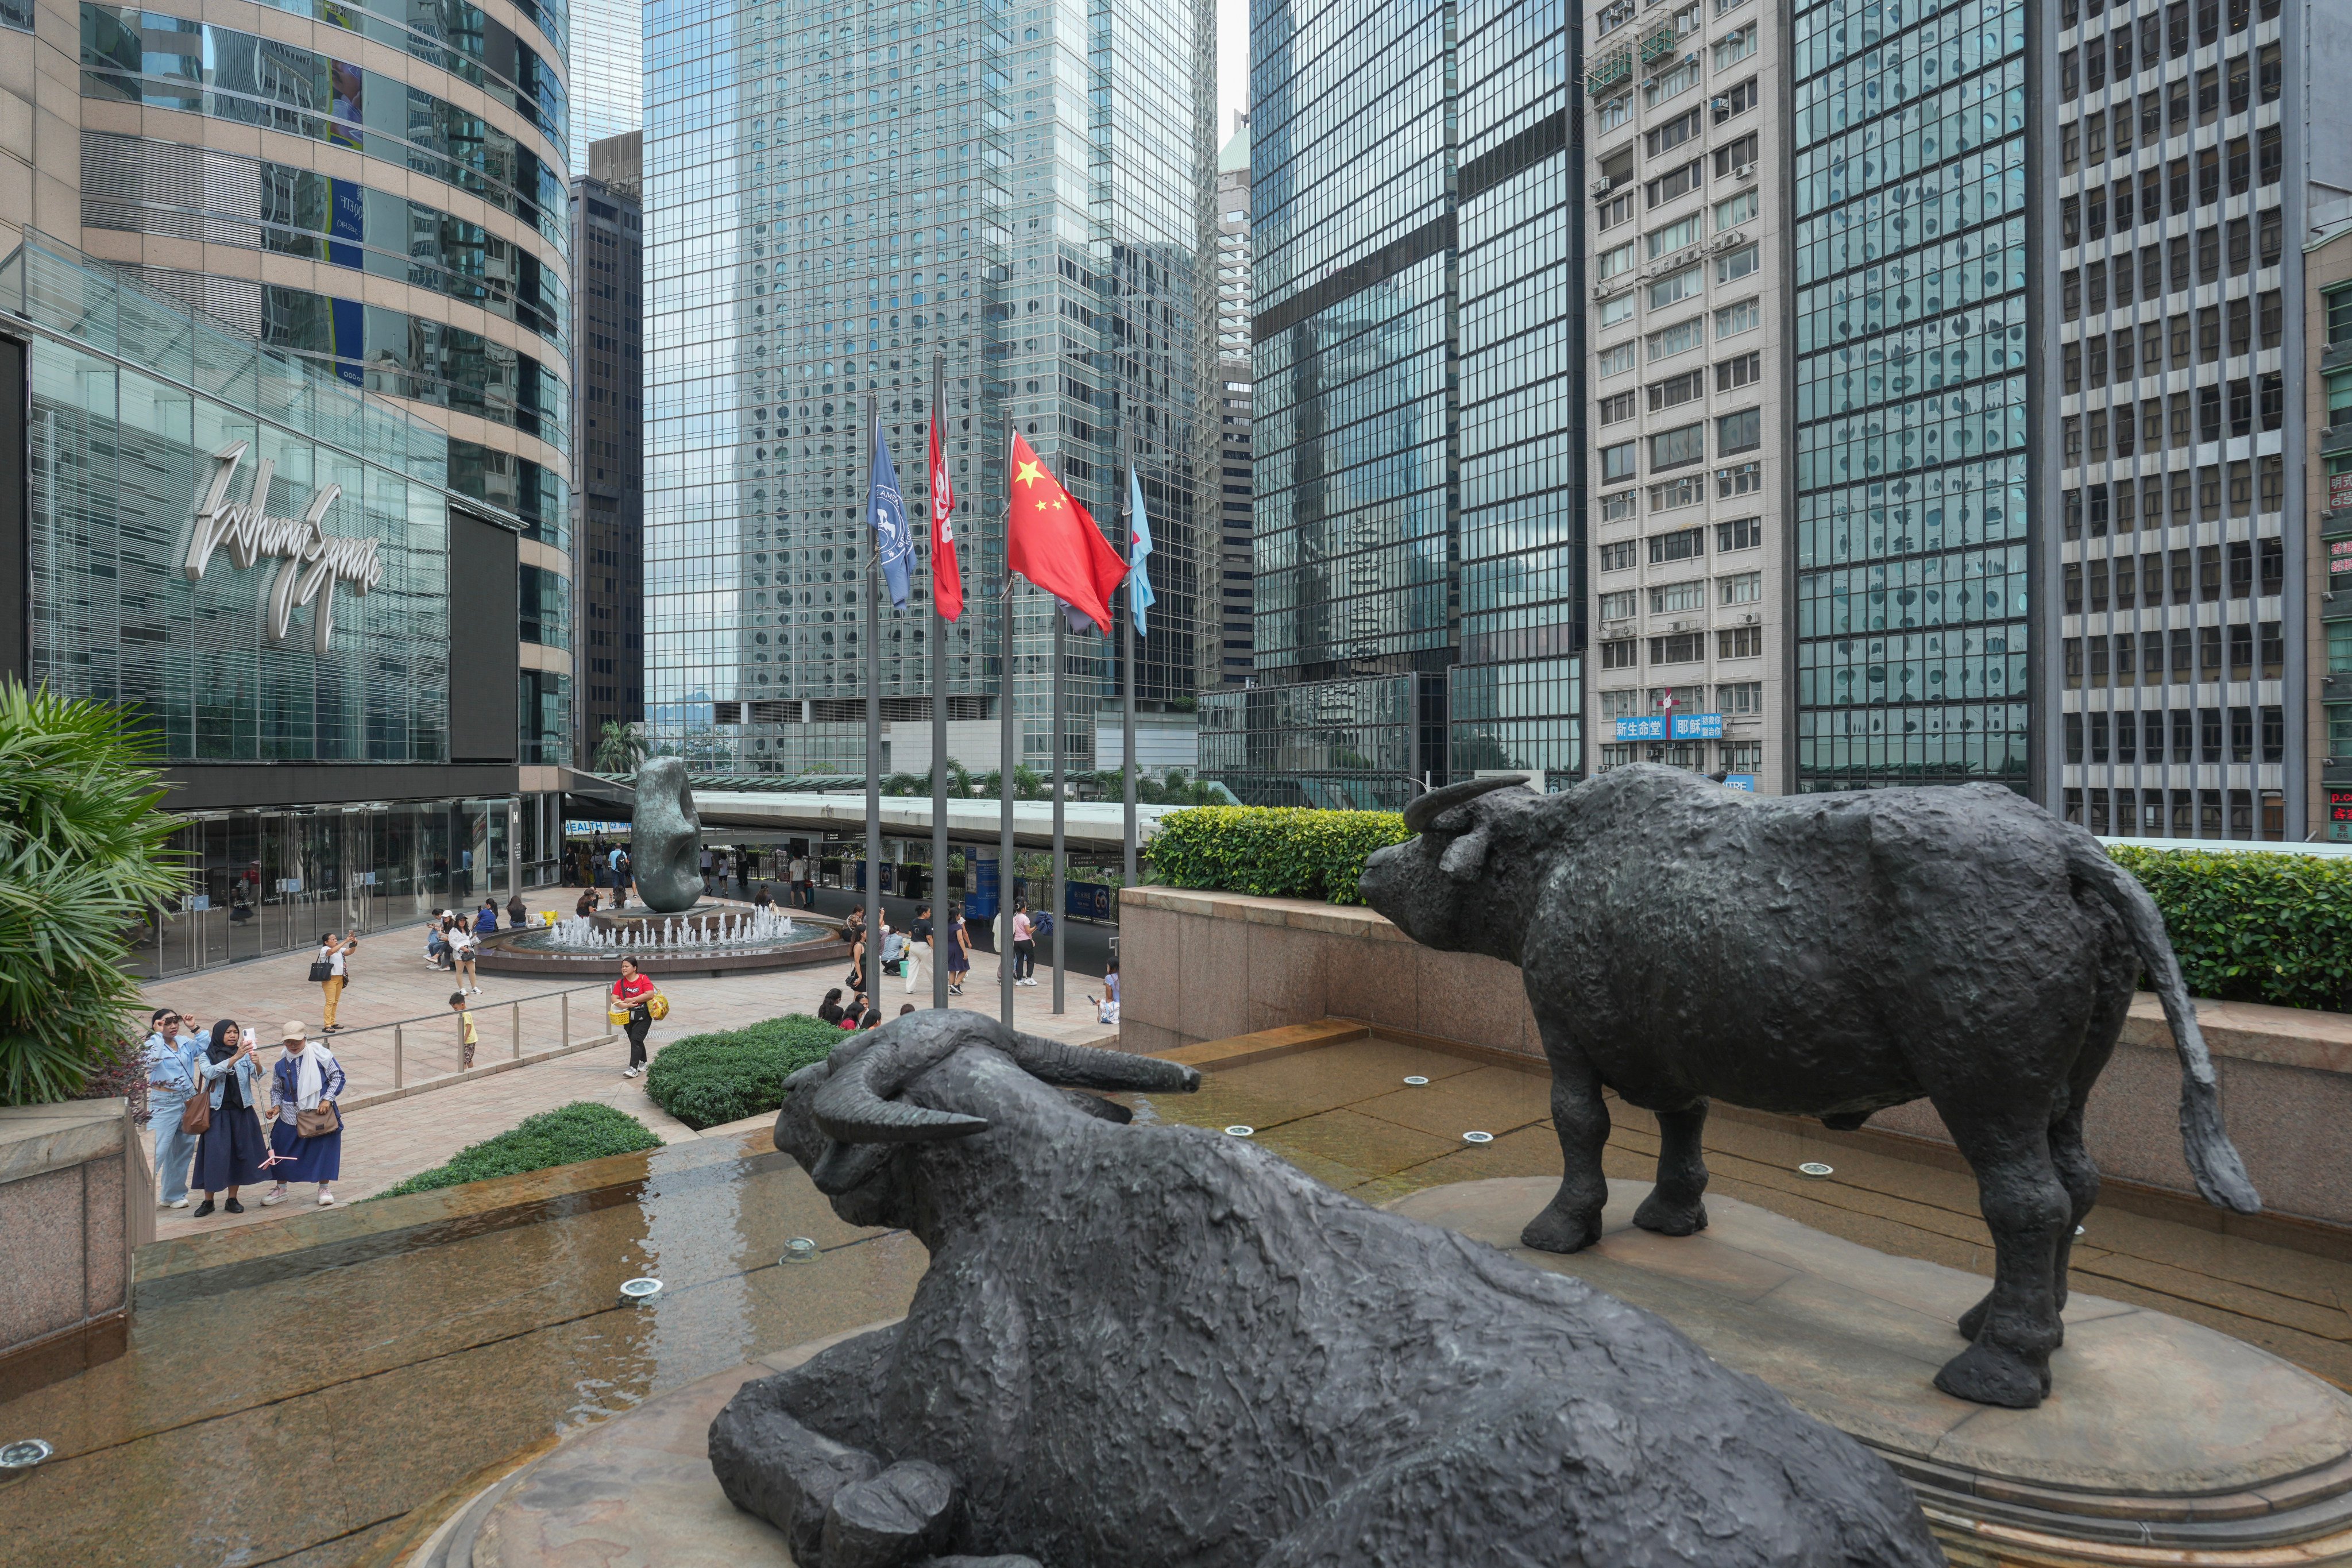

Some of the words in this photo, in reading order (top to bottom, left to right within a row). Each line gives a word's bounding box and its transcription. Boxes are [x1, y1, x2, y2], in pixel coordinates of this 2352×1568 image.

[185, 439, 314, 640] Exchange
[292, 483, 384, 654] Square
[1677, 719, 1701, 735] 耶穌
[1702, 716, 1721, 725] 拯救你
[1616, 721, 1660, 737] 新生命堂
[1702, 727, 1721, 736] 醫治你
